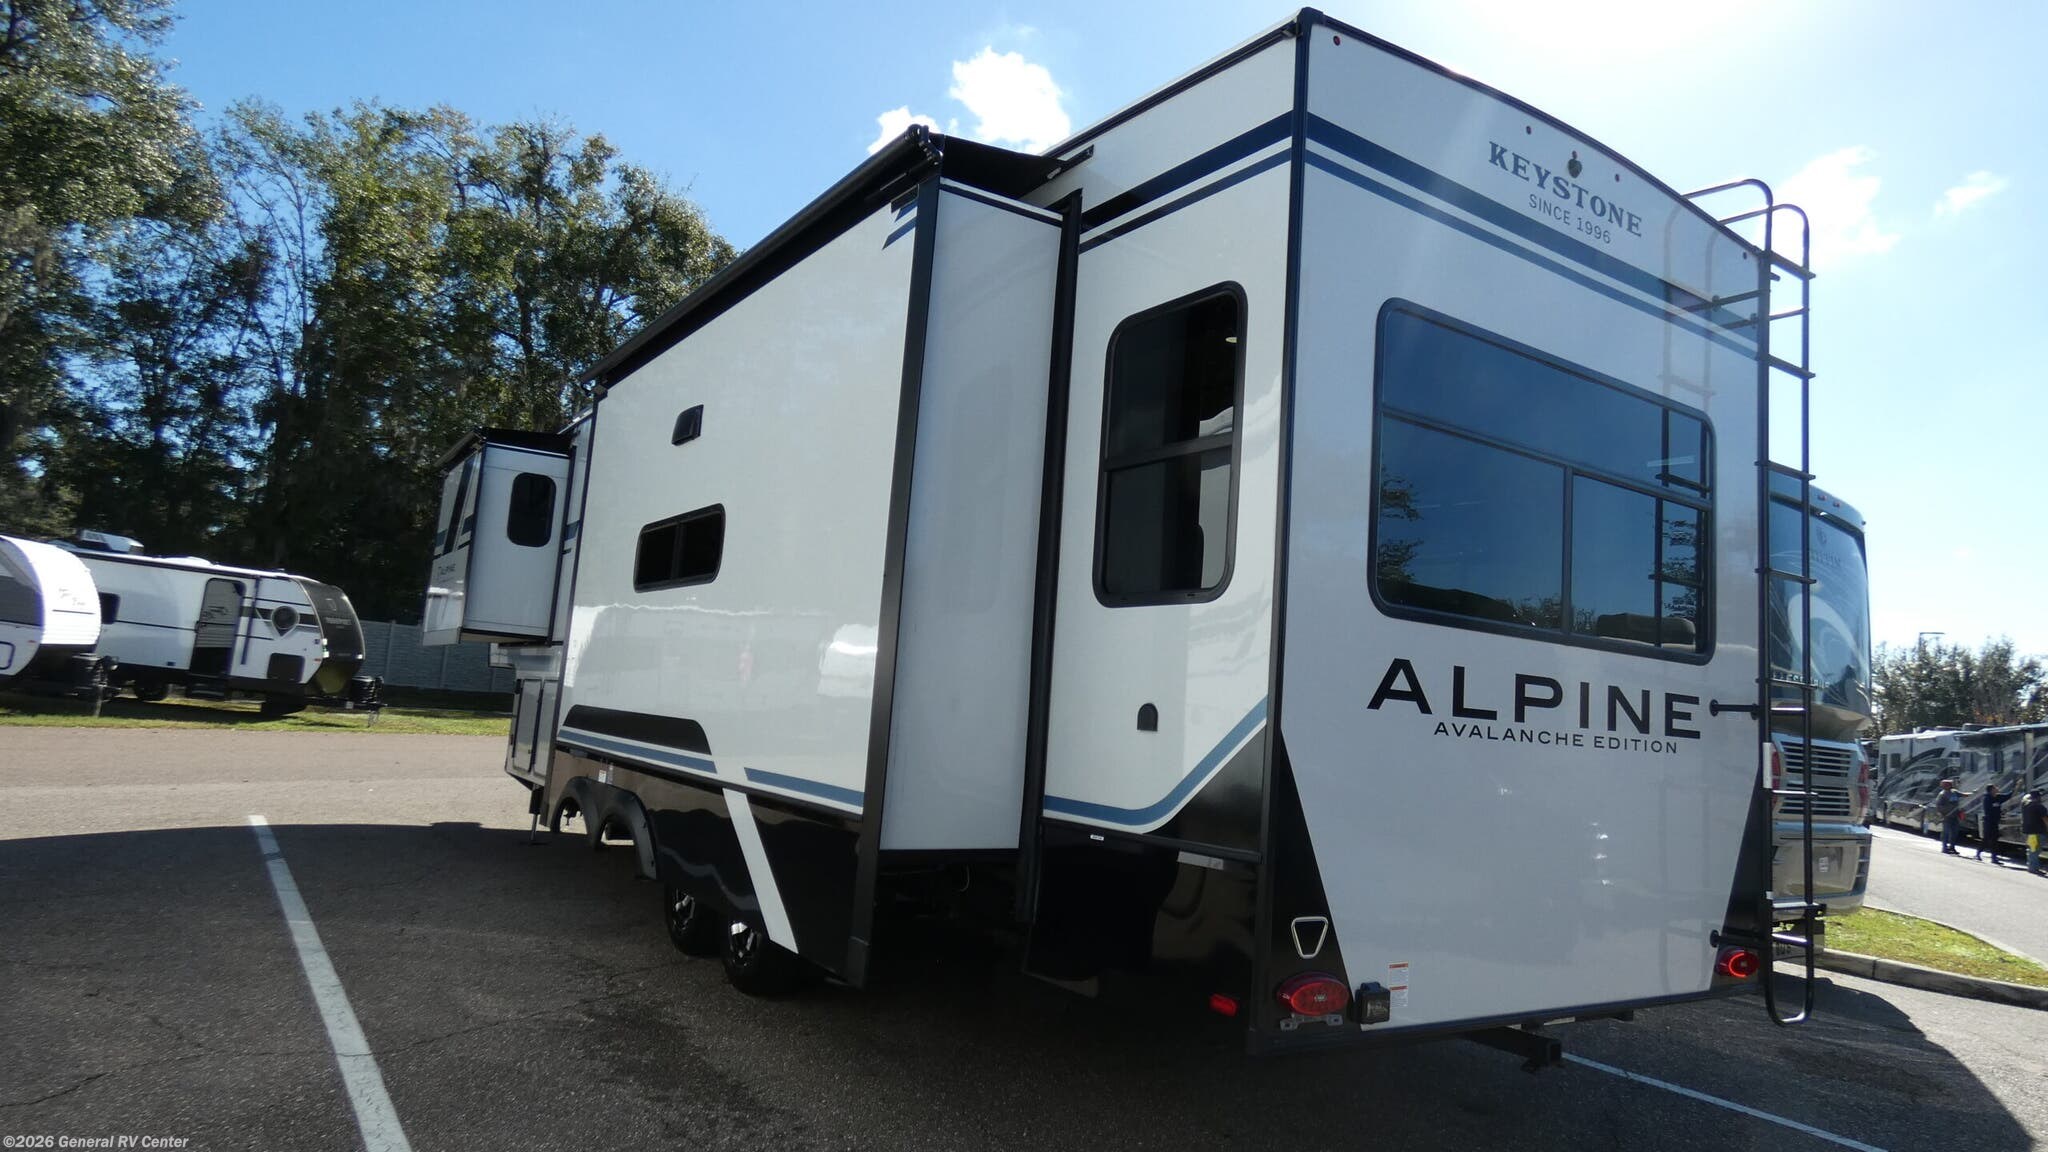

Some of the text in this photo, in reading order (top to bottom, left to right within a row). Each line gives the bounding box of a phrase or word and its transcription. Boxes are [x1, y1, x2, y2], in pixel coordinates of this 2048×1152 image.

[1488, 141, 1642, 237] KEYSTONE
[1528, 193, 1612, 244] SINCE 1996
[1366, 657, 1701, 739] ALPINE
[1434, 721, 1678, 754] AVALANCHE EDITION
